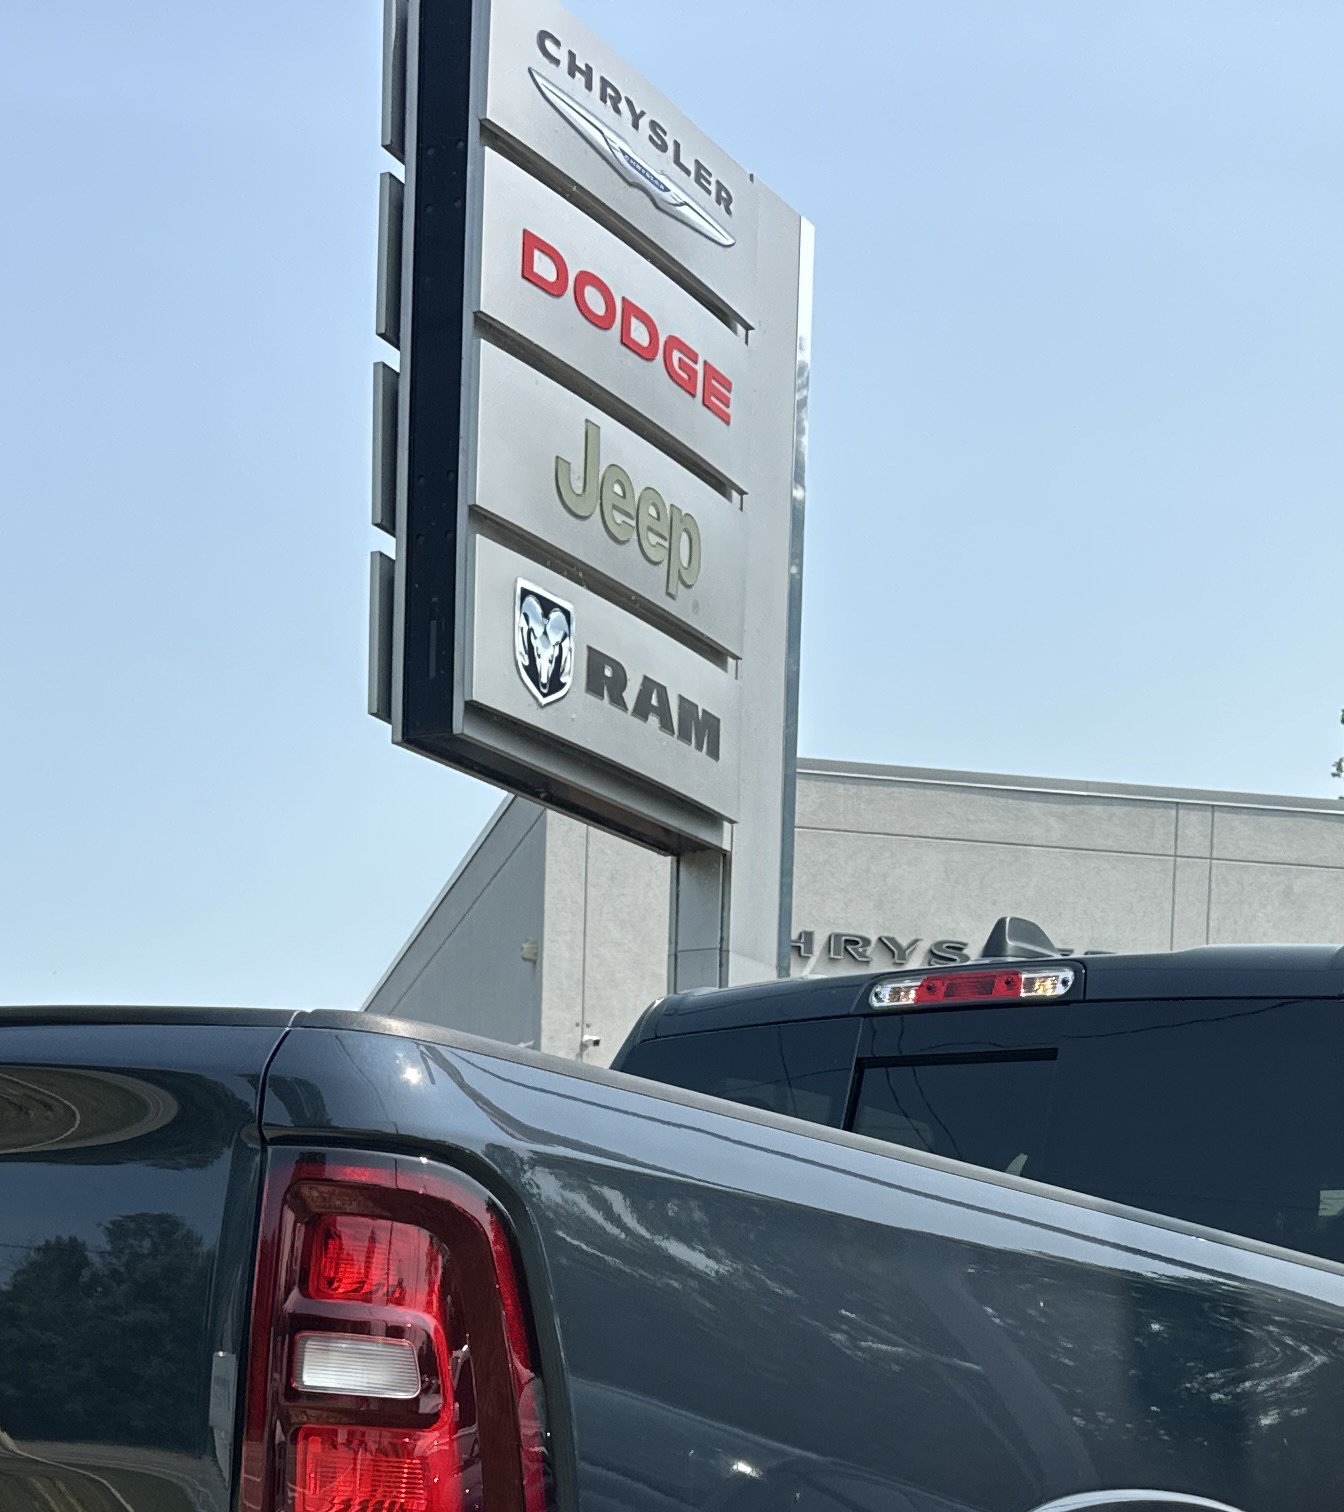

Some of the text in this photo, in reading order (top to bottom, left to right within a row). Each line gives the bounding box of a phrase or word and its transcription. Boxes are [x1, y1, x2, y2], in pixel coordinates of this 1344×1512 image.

[536, 29, 735, 216] CHRYSLER
[521, 228, 733, 426] DODGE
[555, 418, 701, 599] Jeep
[585, 645, 721, 762] RAM
